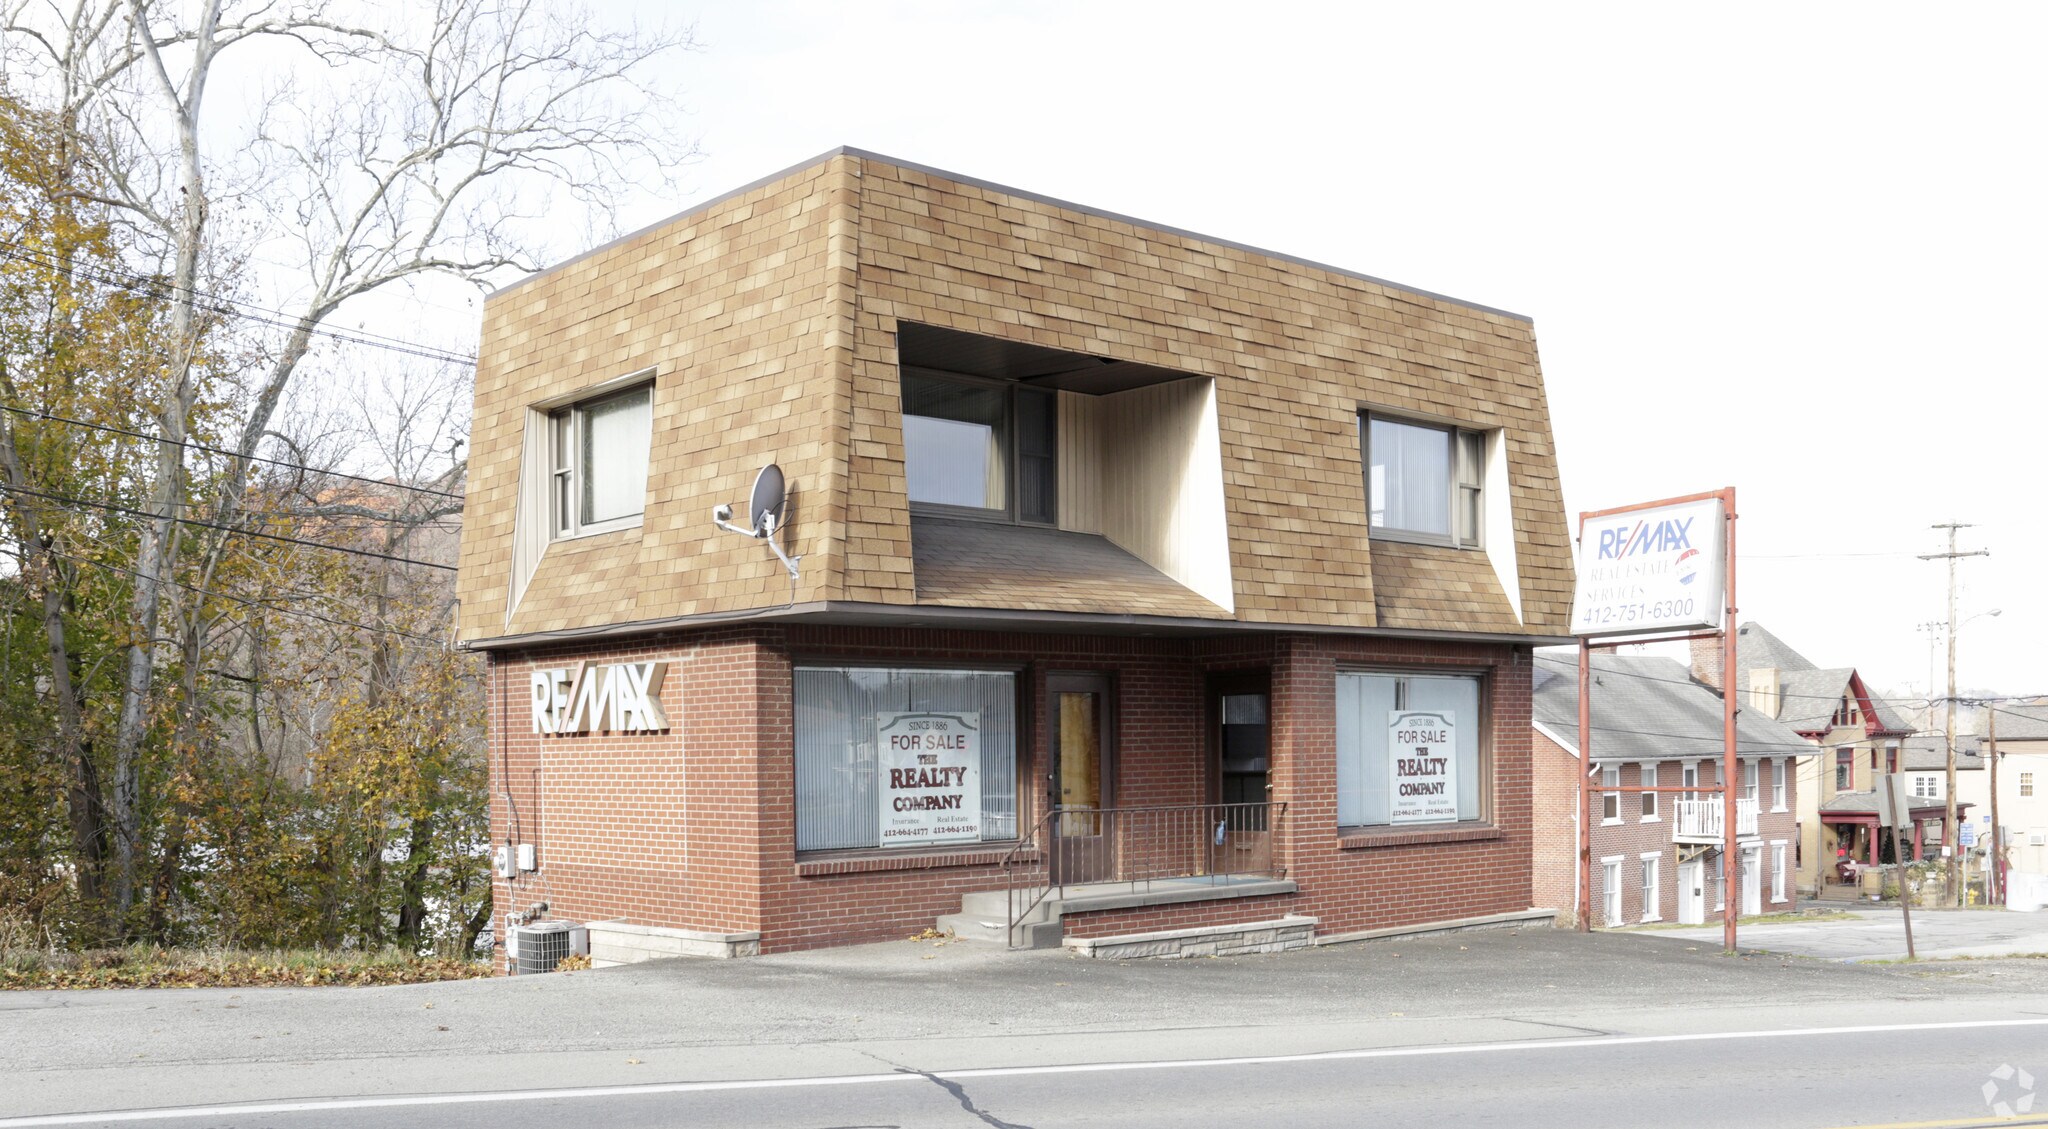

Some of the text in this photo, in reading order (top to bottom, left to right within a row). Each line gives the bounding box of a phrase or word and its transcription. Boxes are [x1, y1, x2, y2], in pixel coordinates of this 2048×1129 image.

[1598, 516, 1695, 560] RE/MAX
[1583, 598, 1694, 624] 412-751-6300
[531, 661, 661, 734] RE/MAX
[908, 721, 948, 731] SINCE 1886
[891, 735, 965, 750] FOR SALE
[1398, 730, 1446, 743] FOR SALE
[1415, 747, 1429, 756] THE
[917, 754, 938, 765] THE
[1397, 758, 1448, 776] REALTY
[890, 767, 967, 789] REALTY
[1399, 782, 1445, 796] COMPANY
[893, 795, 963, 812] COMPANY
[884, 825, 977, 837] 412-664-4177 412-664-1190
